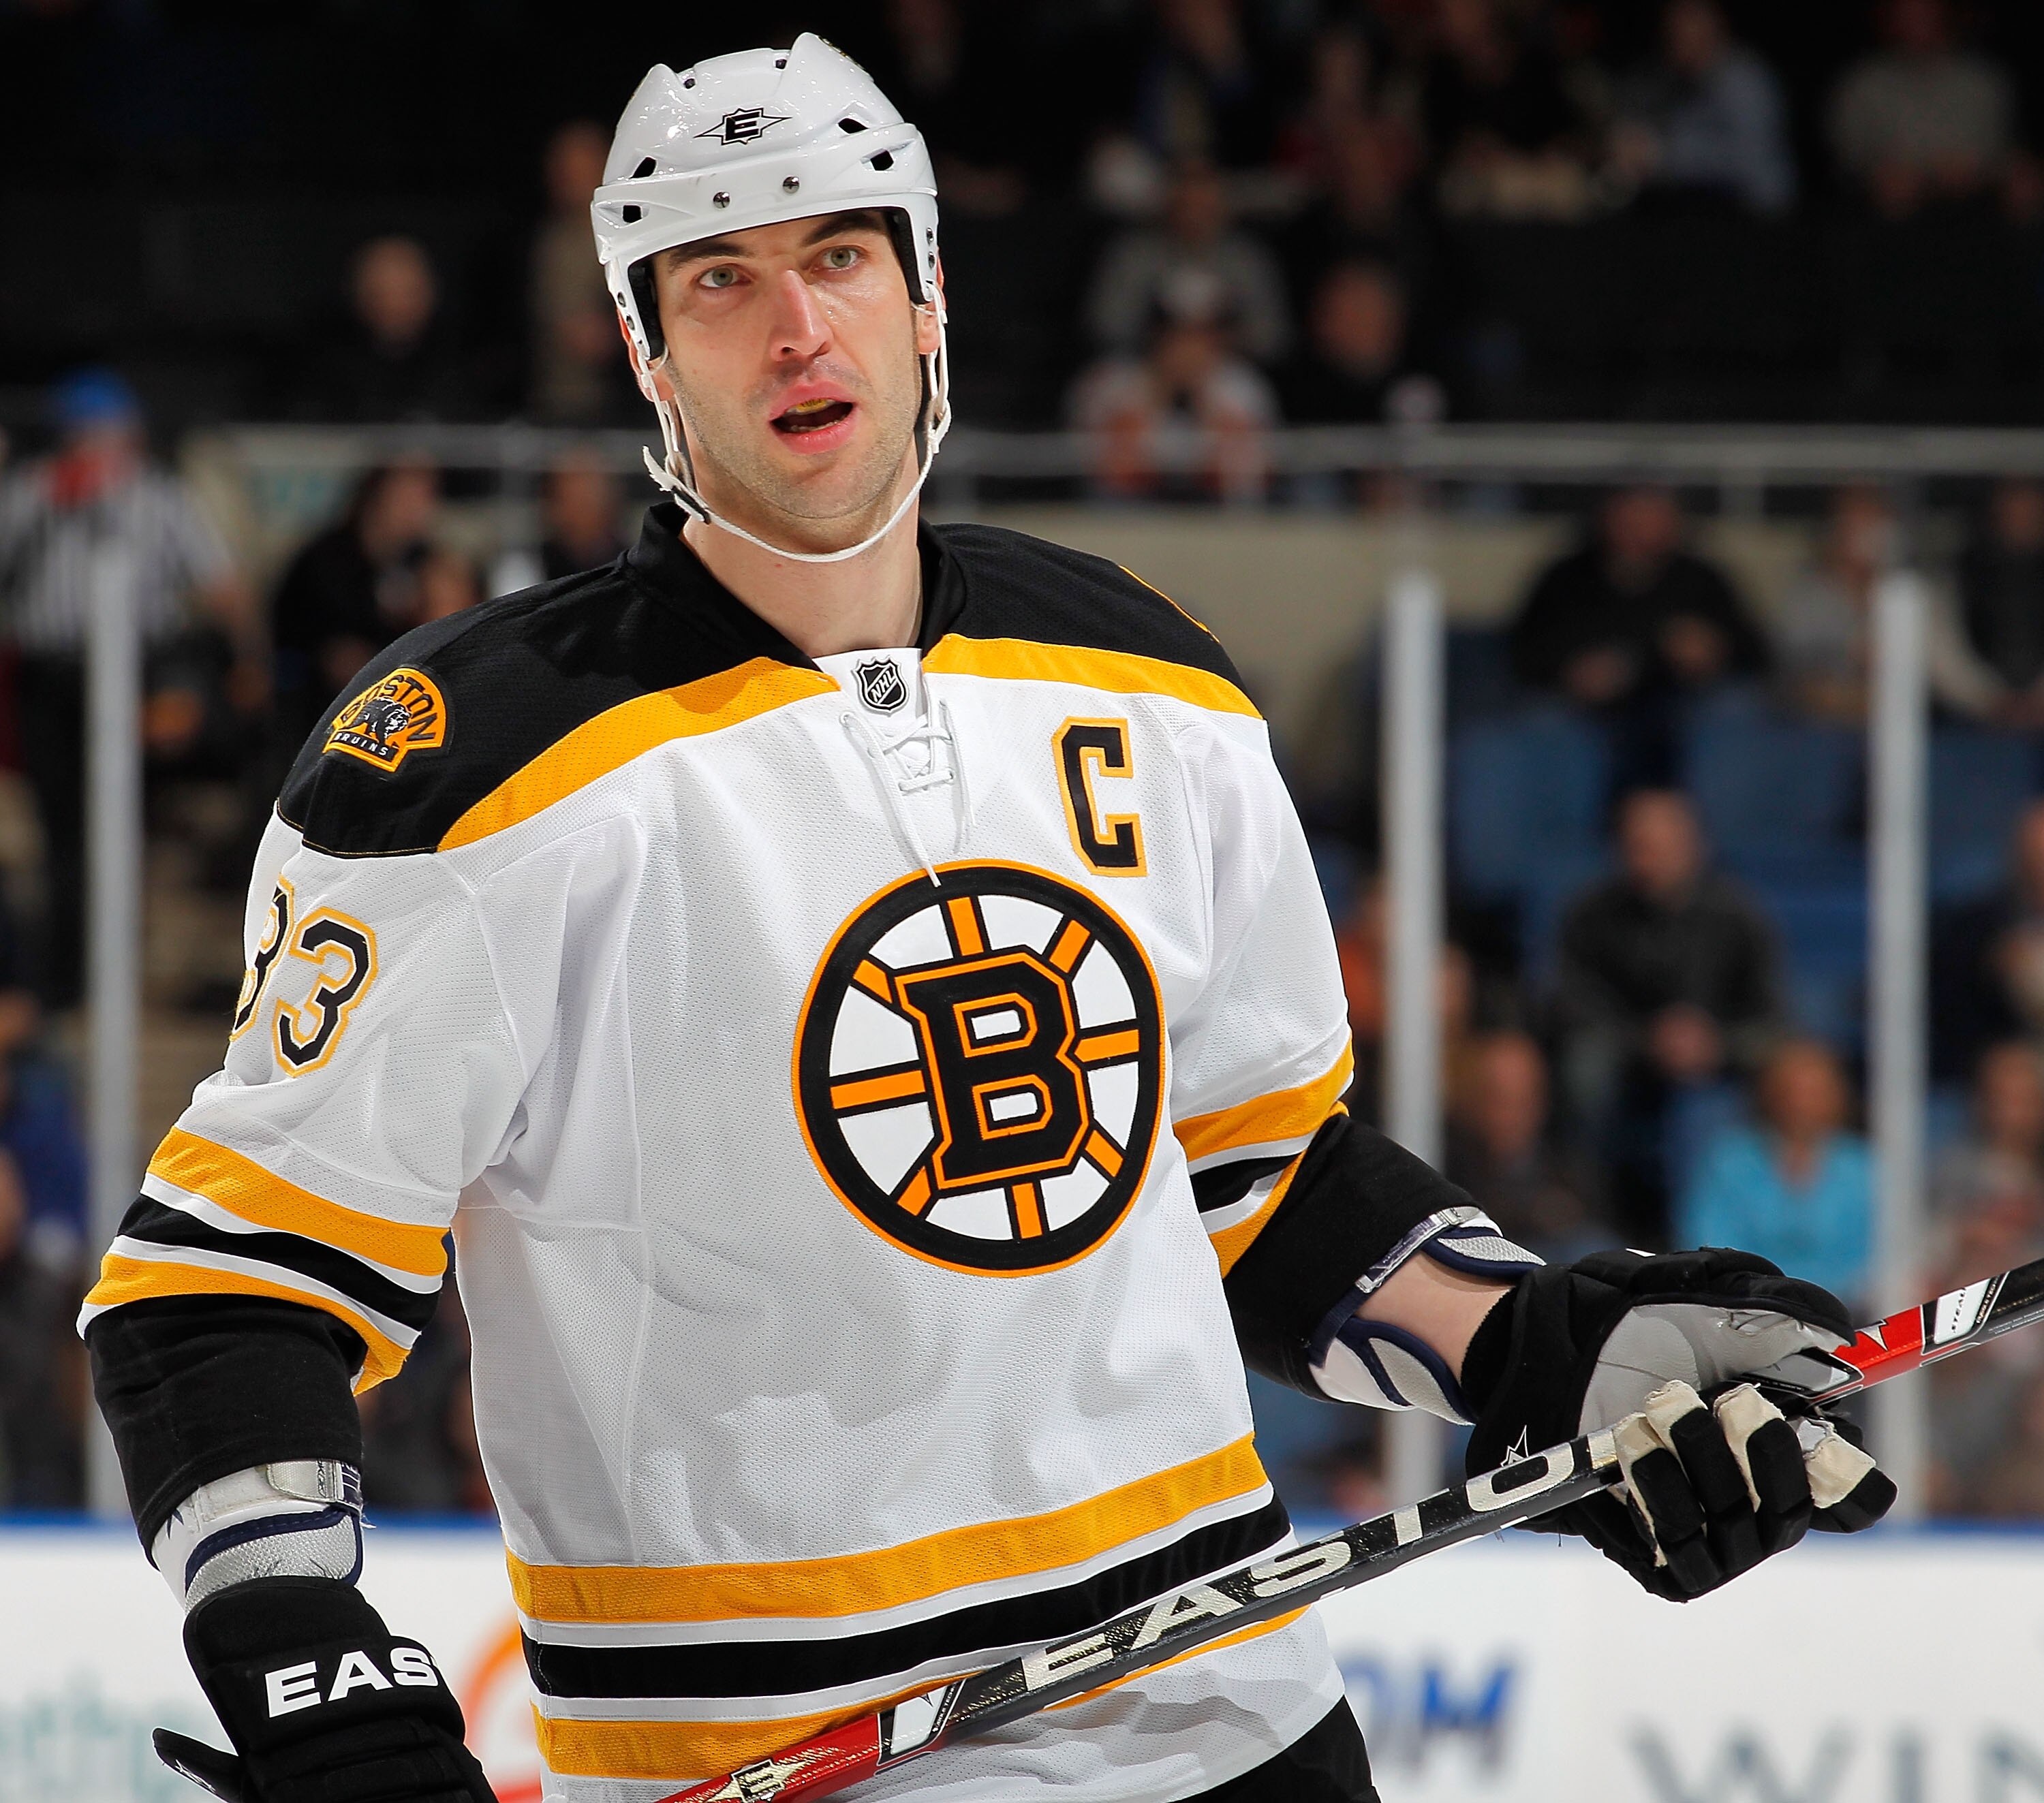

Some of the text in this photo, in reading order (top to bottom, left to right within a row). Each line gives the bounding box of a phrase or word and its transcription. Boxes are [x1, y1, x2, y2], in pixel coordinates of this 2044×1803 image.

[724, 111, 760, 141] E
[339, 674, 438, 742] BOSTON
[871, 670, 895, 702] NHL
[333, 732, 389, 756] BRUINS
[1051, 717, 1147, 877] C
[894, 951, 1090, 1191] B
[266, 1647, 439, 1717] EAS
